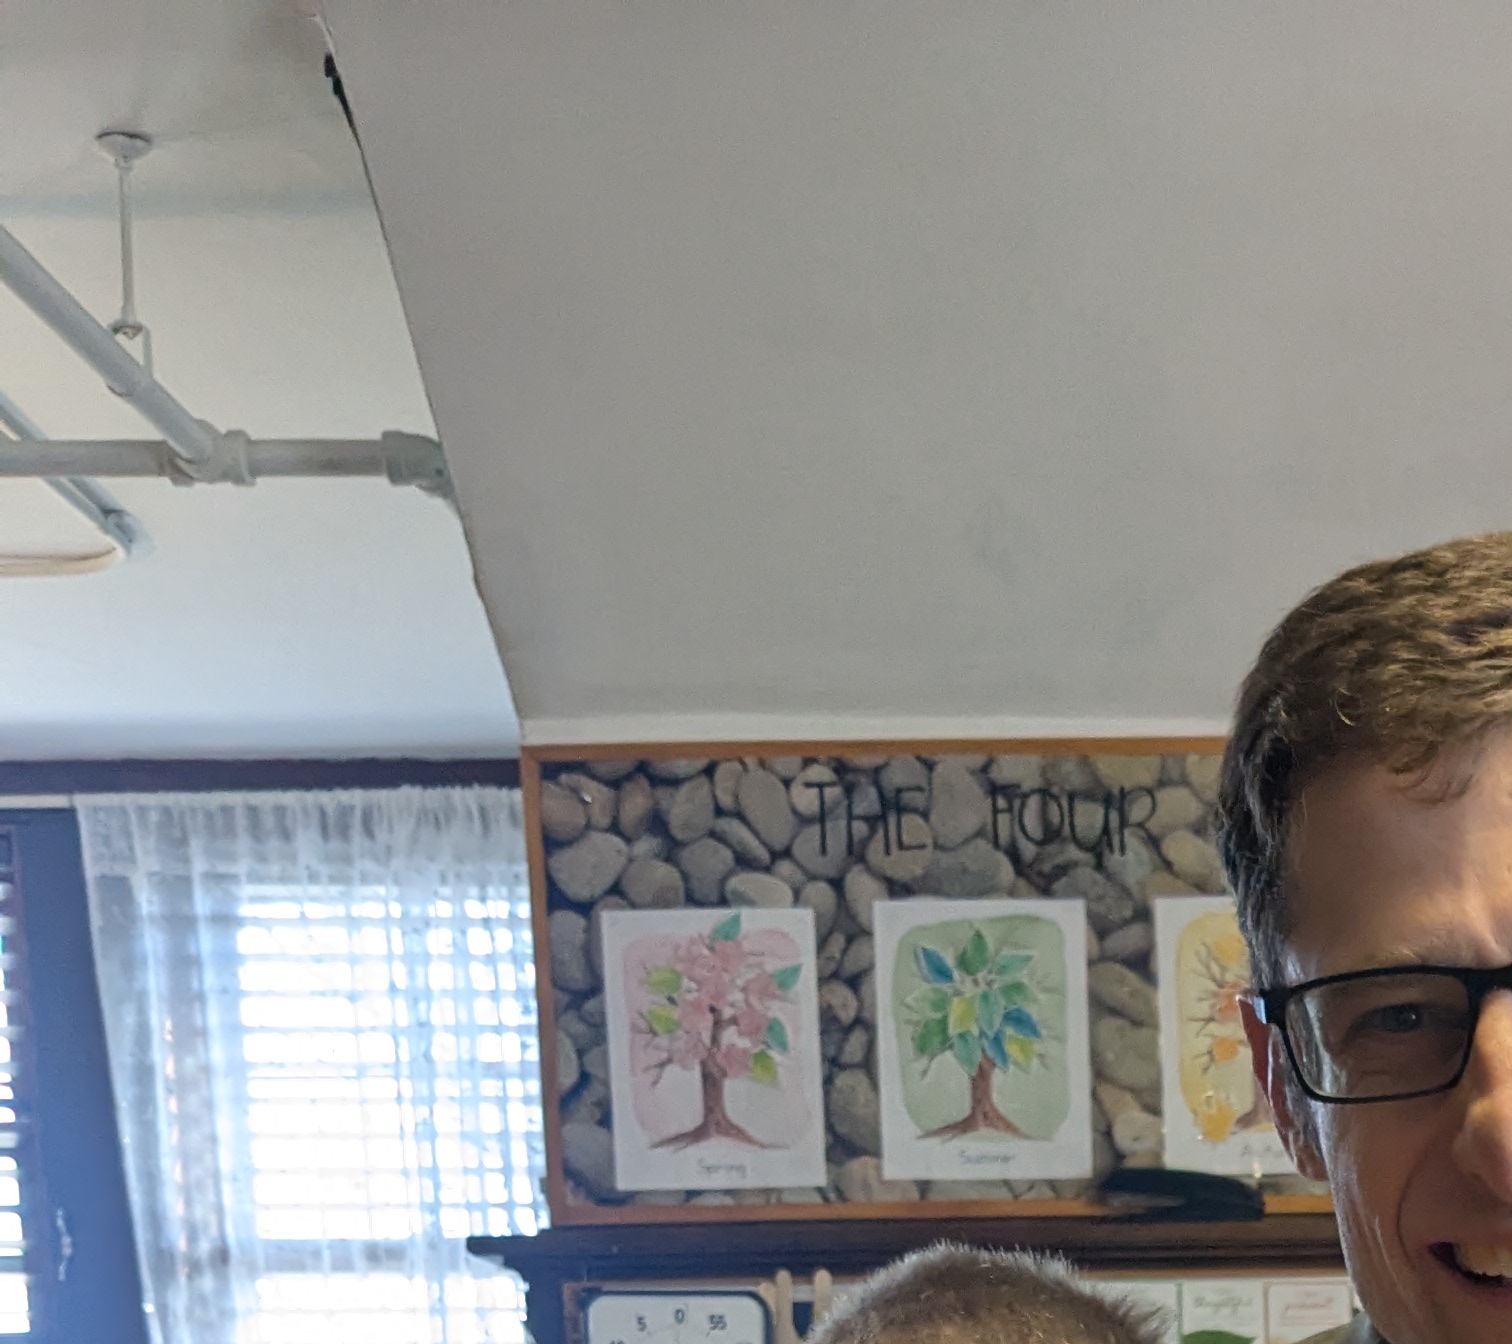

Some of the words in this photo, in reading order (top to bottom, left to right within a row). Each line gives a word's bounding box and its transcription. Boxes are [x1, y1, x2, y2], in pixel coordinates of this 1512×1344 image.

[802, 780, 928, 857] THE
[989, 781, 1158, 857] FOUR
[636, 1314, 648, 1332] 5
[674, 1308, 686, 1325] 0
[709, 1314, 728, 1331] 55
